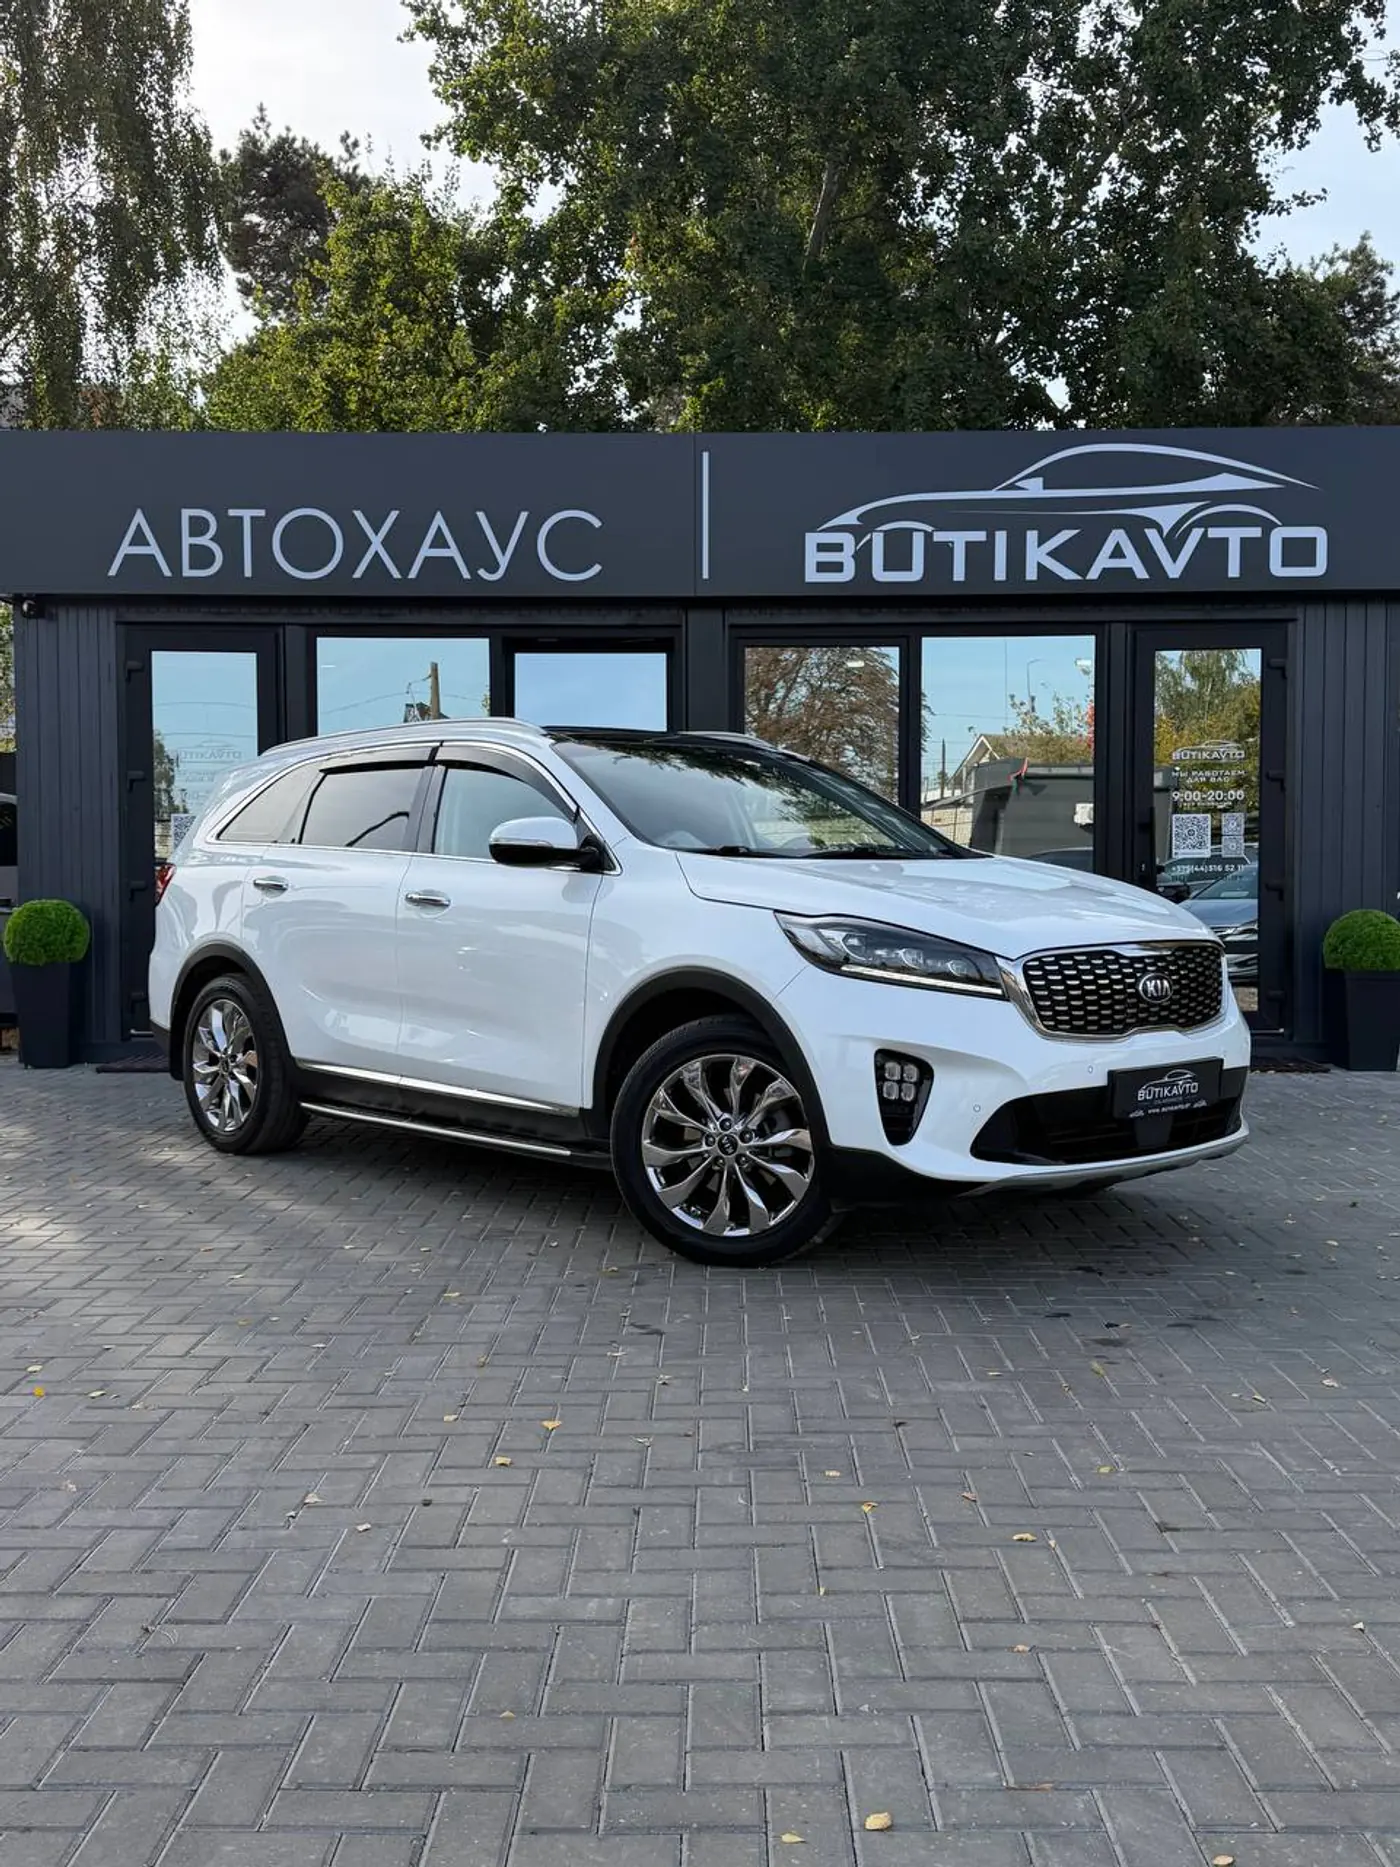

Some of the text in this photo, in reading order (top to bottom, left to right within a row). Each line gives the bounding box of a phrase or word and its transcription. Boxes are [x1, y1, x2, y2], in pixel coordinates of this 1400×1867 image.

[107, 508, 603, 581] АВТОХАУС
[804, 525, 1328, 583] BUTIKAVTO
[1172, 750, 1245, 760] BUTIKAVTO
[1172, 790, 1245, 801] 9:00-20:00
[1146, 979, 1171, 998] KIA
[1137, 1082, 1199, 1101] BUTIKAVTO
